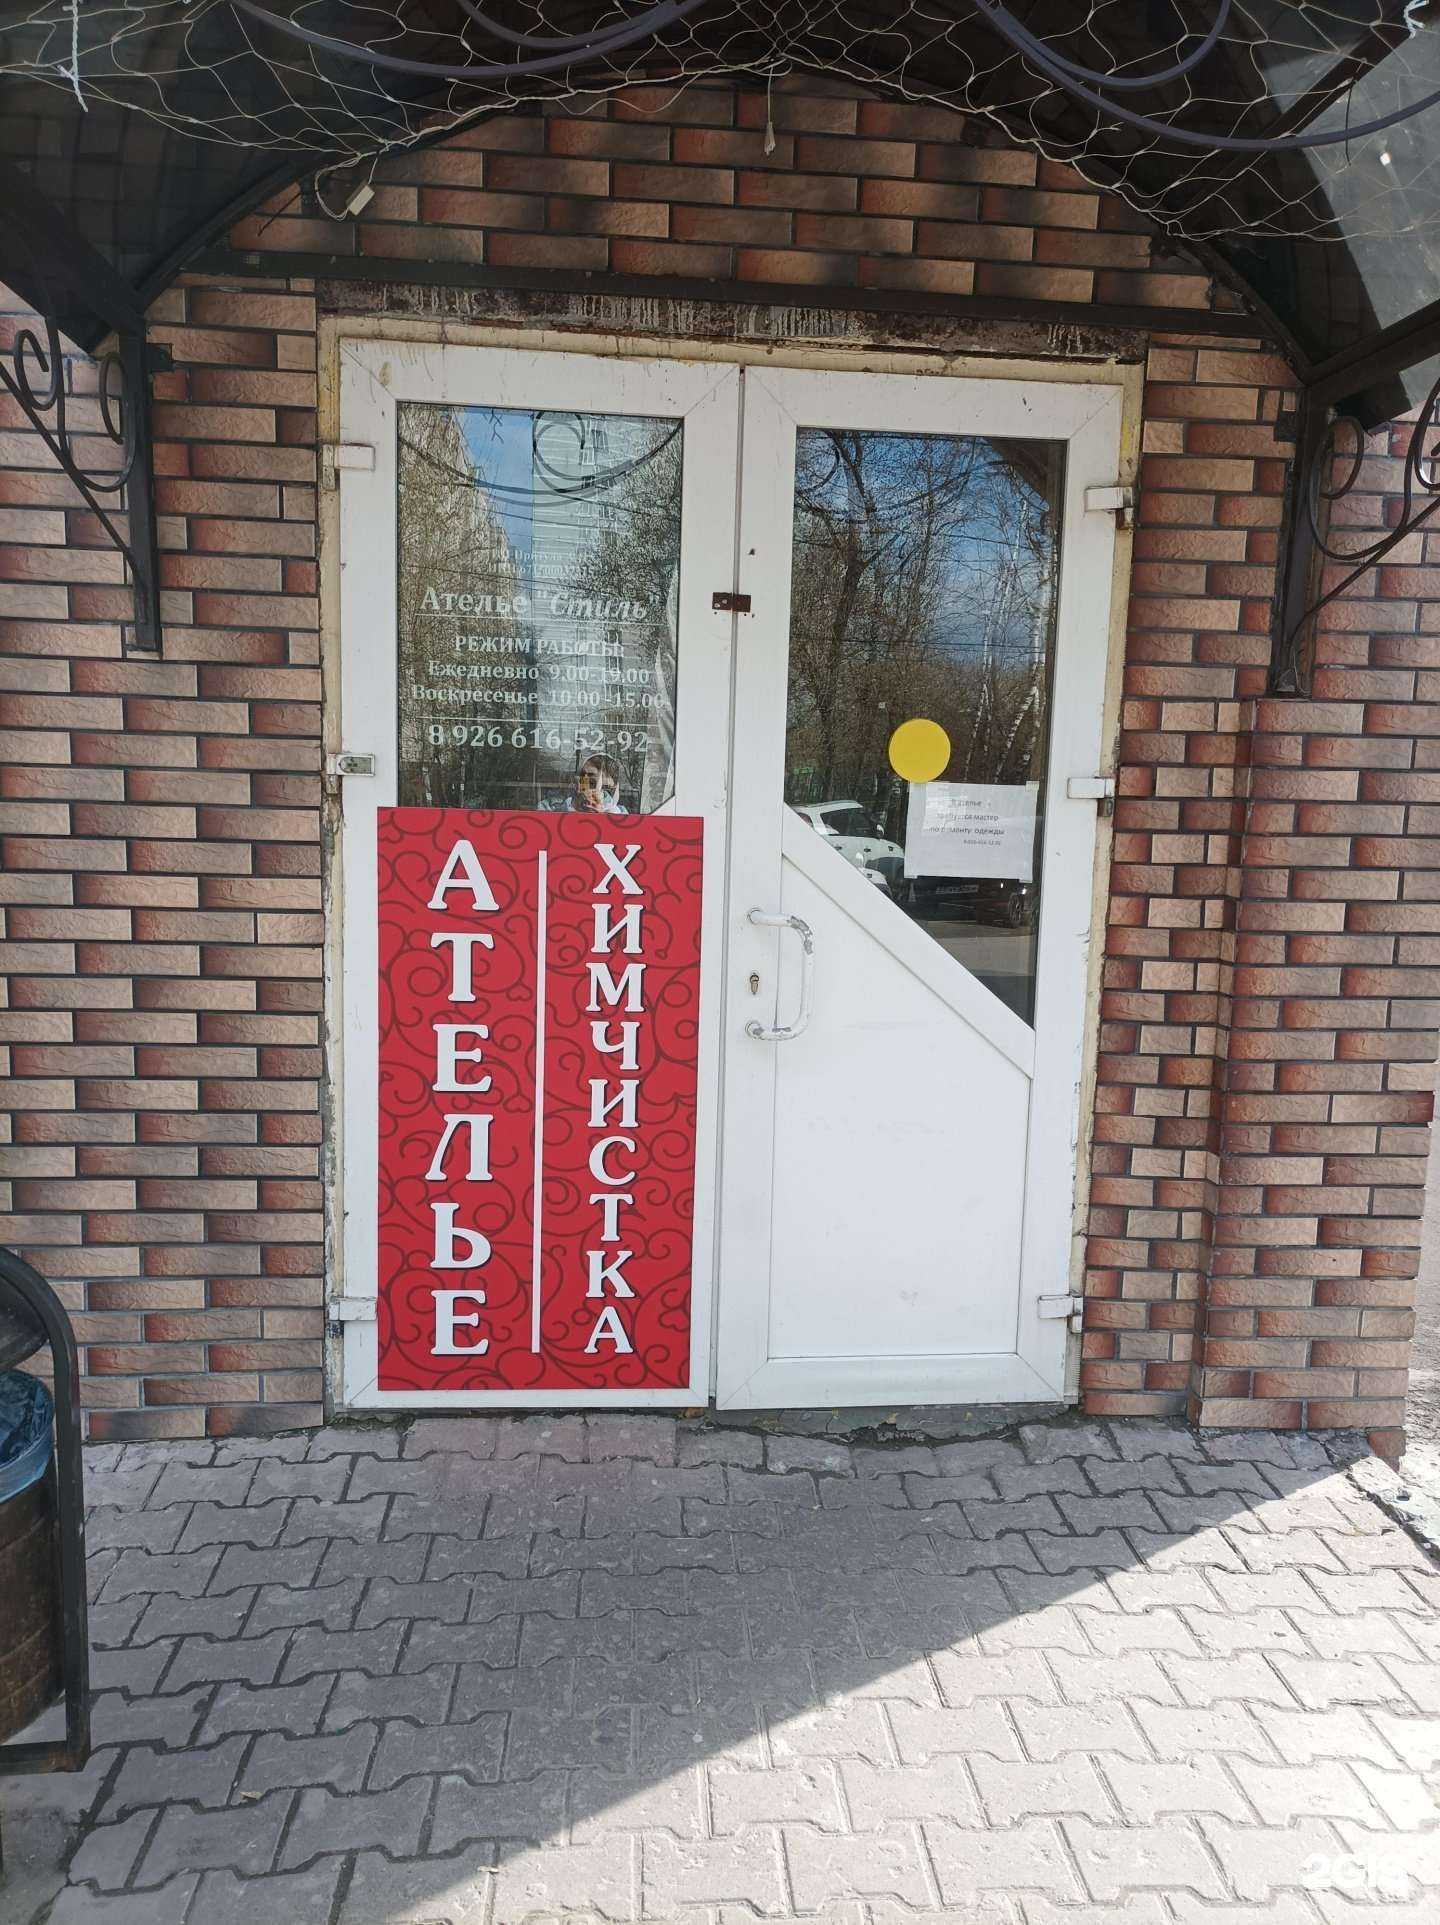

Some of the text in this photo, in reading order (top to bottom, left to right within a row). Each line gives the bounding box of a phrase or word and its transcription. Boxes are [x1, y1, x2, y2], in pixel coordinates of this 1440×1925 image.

[420, 587, 528, 614] Ателье
[455, 635, 532, 653] РЕЖИМ
[429, 660, 540, 680] Ежедневно
[414, 684, 538, 705] Воскресенье
[428, 725, 649, 752] 8 926 616-52-92
[974, 828, 1005, 836] одежды
[426, 839, 499, 1357] АТЕЛЬЕ
[584, 843, 647, 1355] ХИМЧИСТКА
